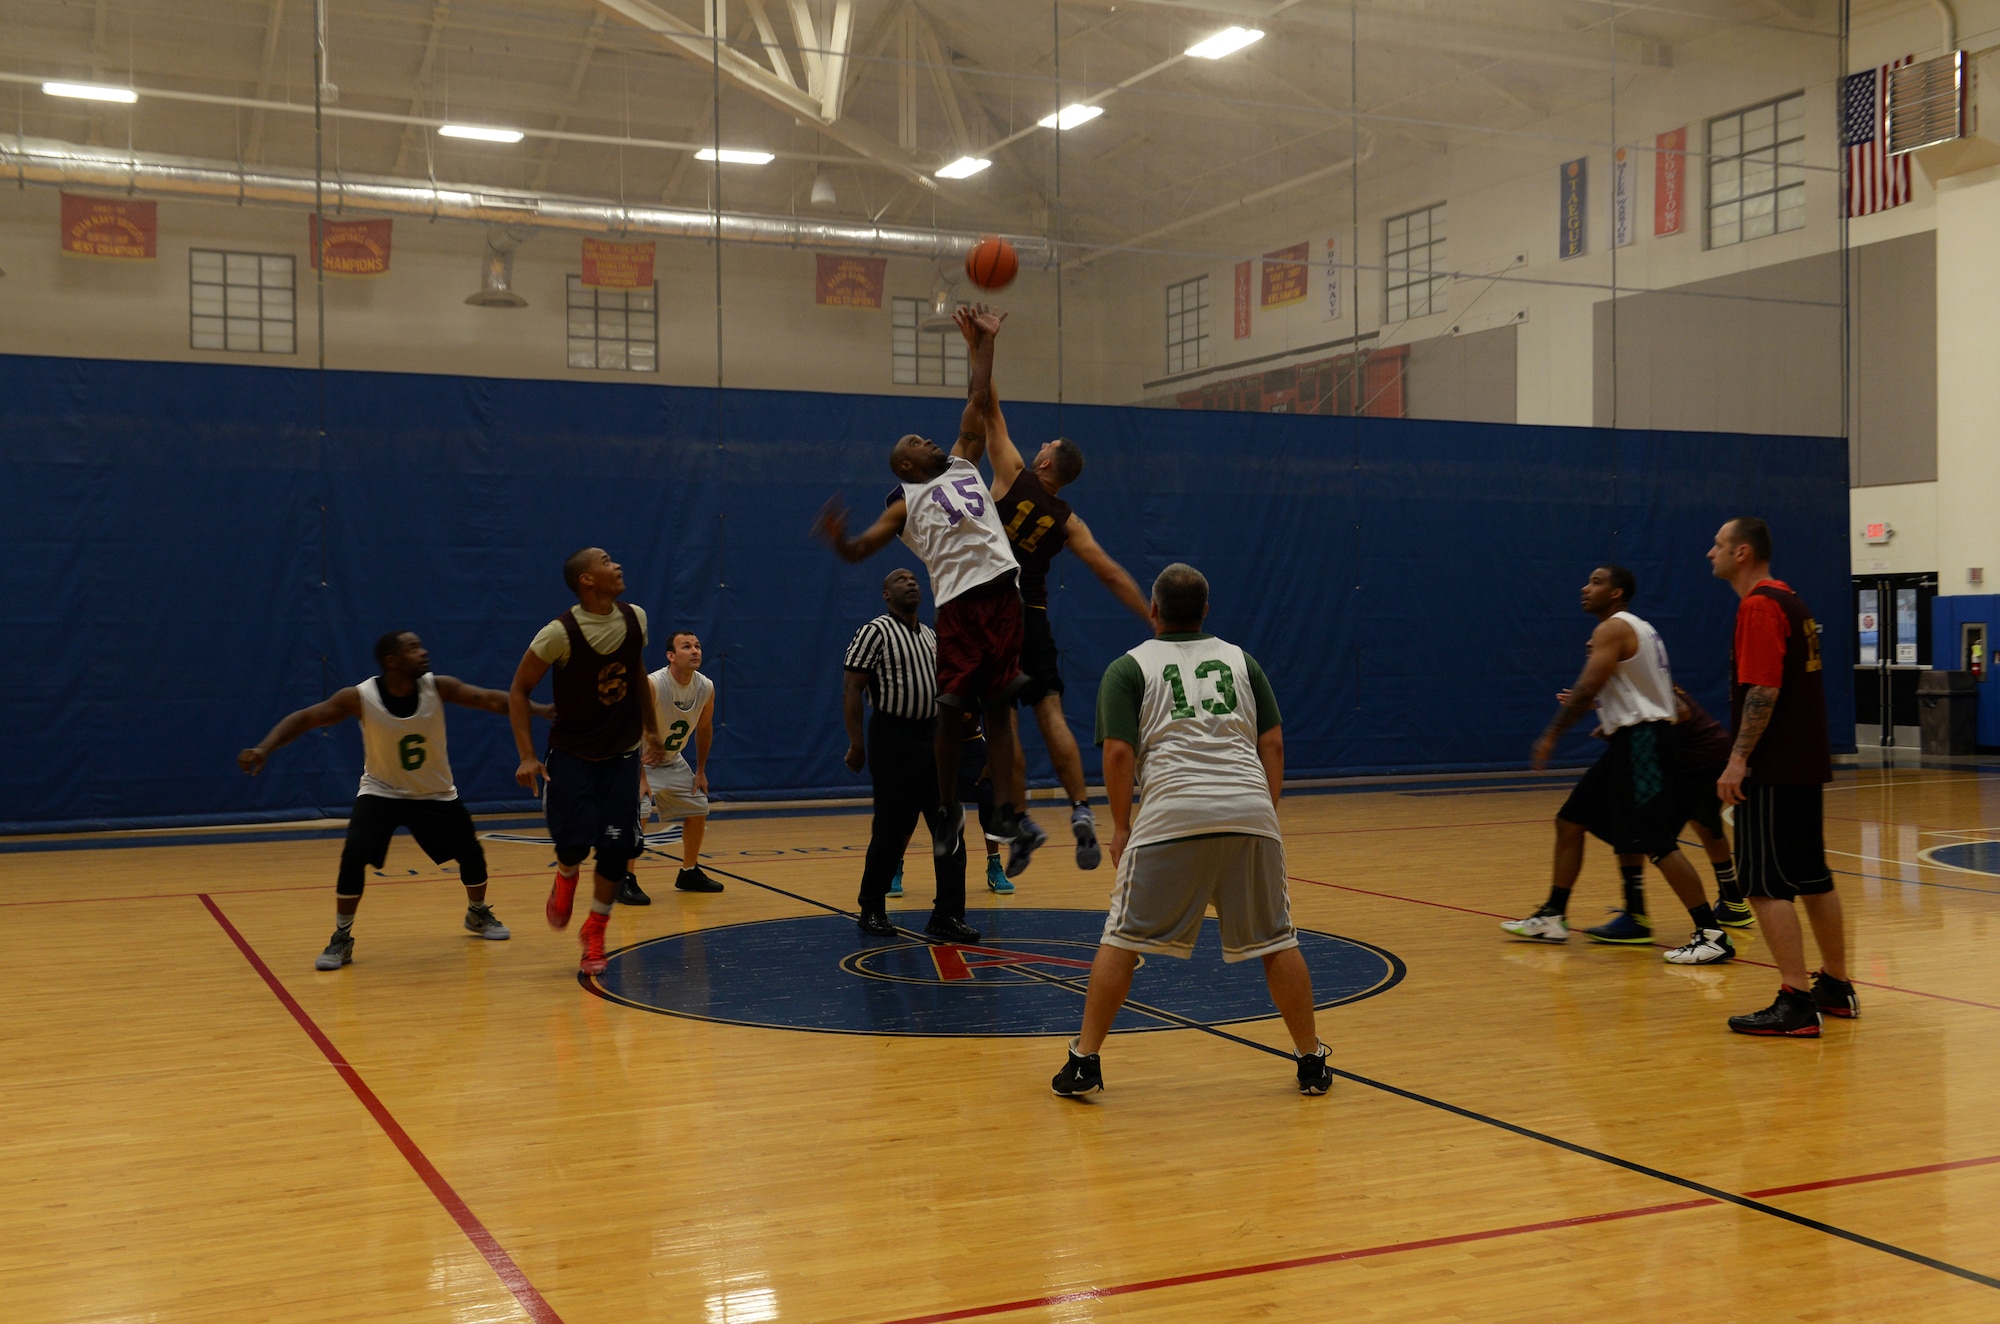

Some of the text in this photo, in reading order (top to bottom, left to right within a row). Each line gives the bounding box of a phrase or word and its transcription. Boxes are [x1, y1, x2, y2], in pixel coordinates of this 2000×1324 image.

[1567, 178, 1580, 256] TAEGUE
[1665, 150, 1677, 231] DOWNTOWN
[1327, 250, 1337, 317] BIG NAVY
[932, 476, 985, 526] 15
[1004, 499, 1057, 554] 11
[597, 661, 628, 706] 6
[1162, 659, 1238, 720] 13
[398, 734, 427, 772] 6
[664, 720, 690, 751] 2
